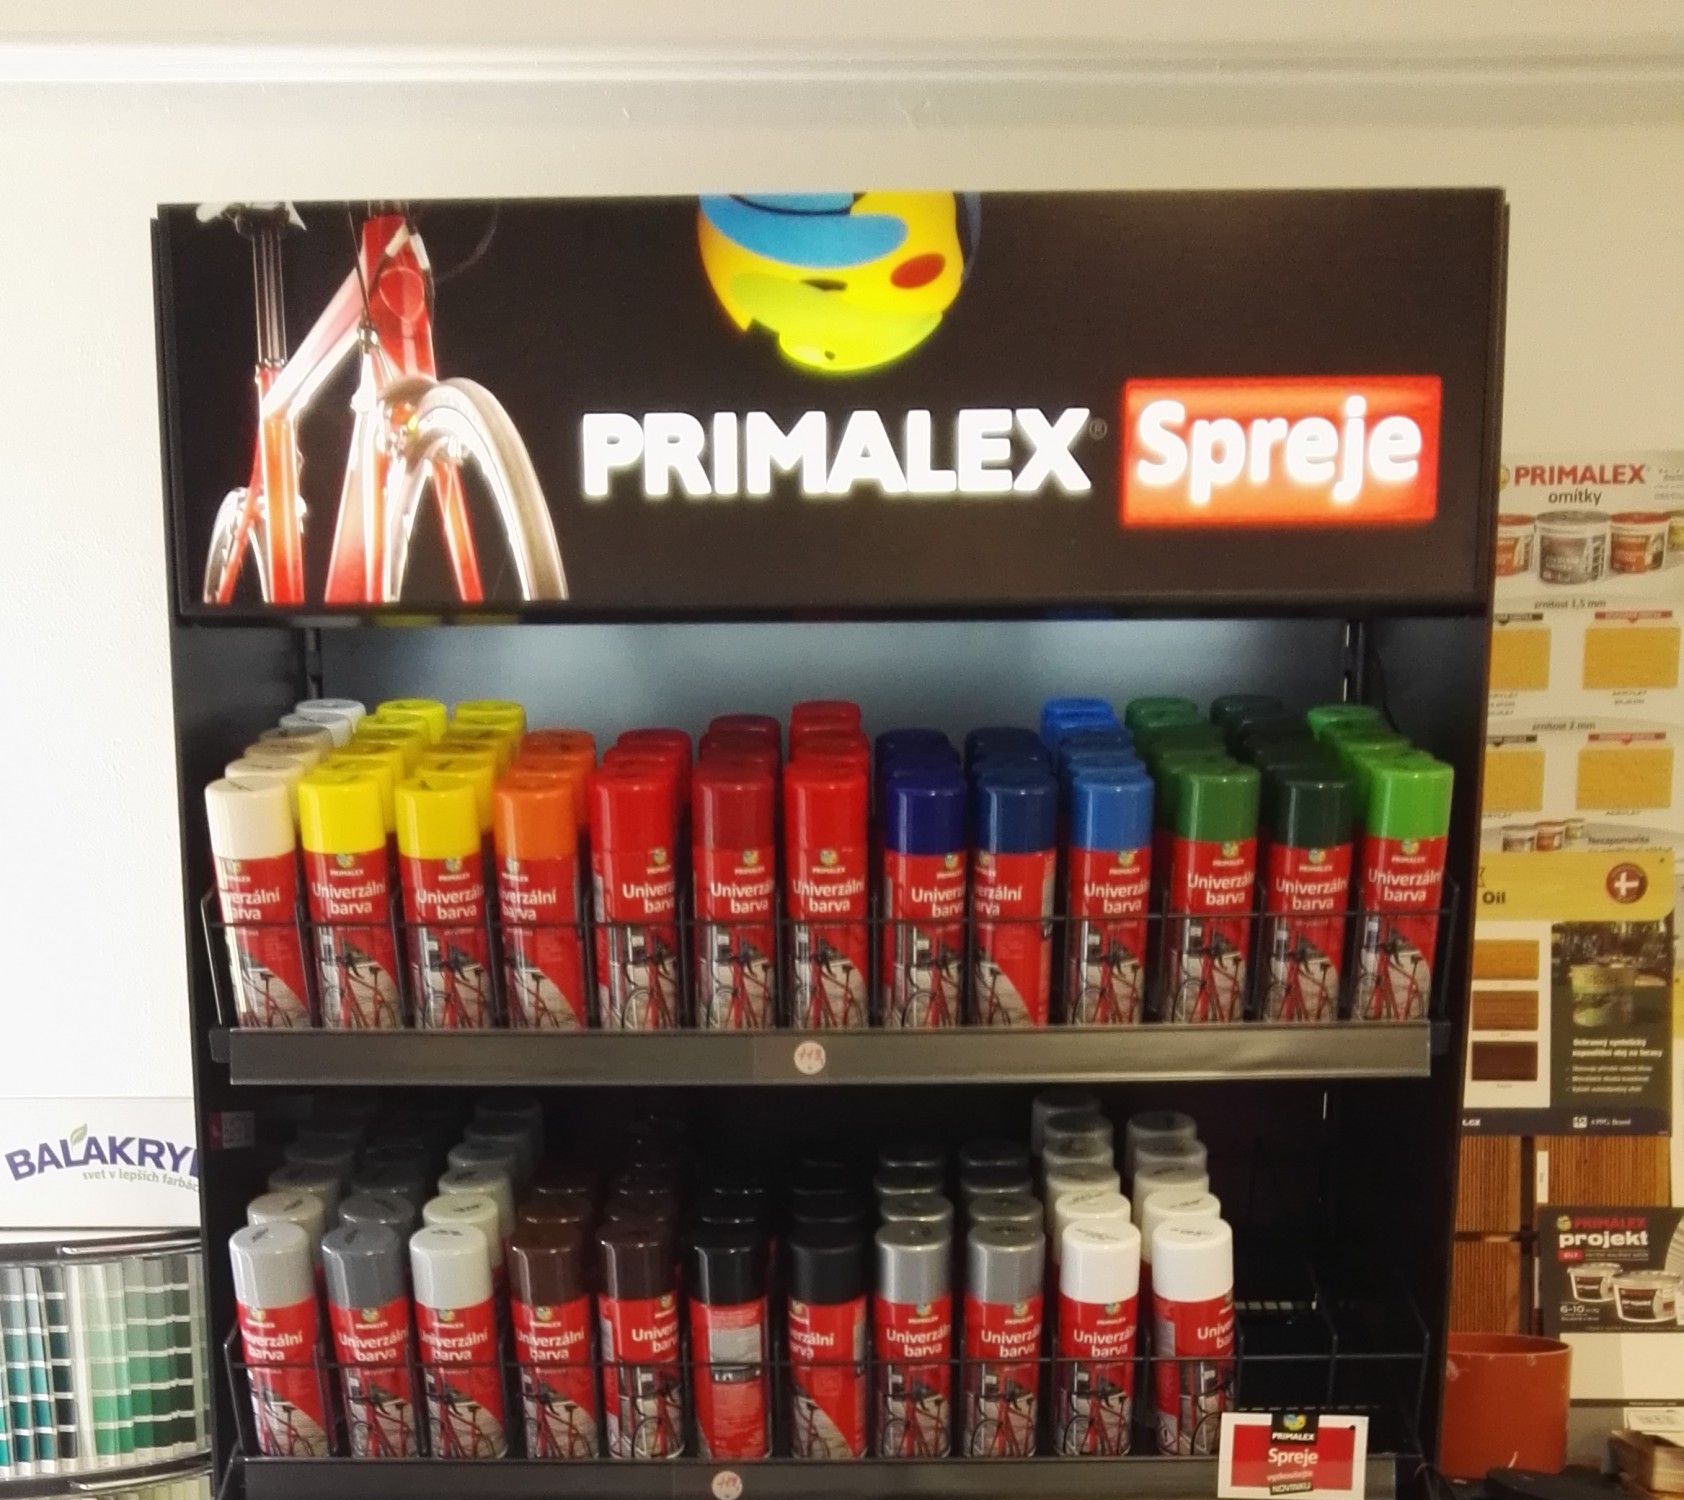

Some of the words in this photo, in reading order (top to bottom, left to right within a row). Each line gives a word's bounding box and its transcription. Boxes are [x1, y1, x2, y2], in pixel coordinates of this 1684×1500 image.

[583, 409, 1091, 496] PRIMALEX
[1136, 396, 1421, 506] Spreje
[1514, 464, 1646, 486] PRIMALEX
[1548, 488, 1602, 506] omítky
[710, 877, 775, 899] Univerzál
[1383, 886, 1427, 902] barva
[730, 898, 769, 914] barva
[808, 897, 851, 913] barva
[1102, 898, 1142, 914] barva
[1205, 890, 1245, 906] barva
[1292, 895, 1334, 911] barva
[1482, 891, 1506, 905] Oil
[330, 901, 373, 915] barva
[436, 904, 477, 920] barva
[82, 1168, 106, 1180] svet
[109, 1170, 115, 1179] v
[119, 1168, 159, 1184] lepších
[162, 1173, 199, 1193] farbác
[1572, 1217, 1647, 1230] PRIMALEX
[1558, 1230, 1649, 1249] projekt
[356, 1348, 397, 1362] barva
[433, 1347, 472, 1362] barva
[528, 1346, 569, 1361] barva
[903, 1342, 943, 1358] barva
[999, 1341, 1036, 1358] barva
[1091, 1341, 1128, 1358] barva
[1272, 1432, 1316, 1441] PRIMALEX
[1268, 1448, 1319, 1468] Spreje
